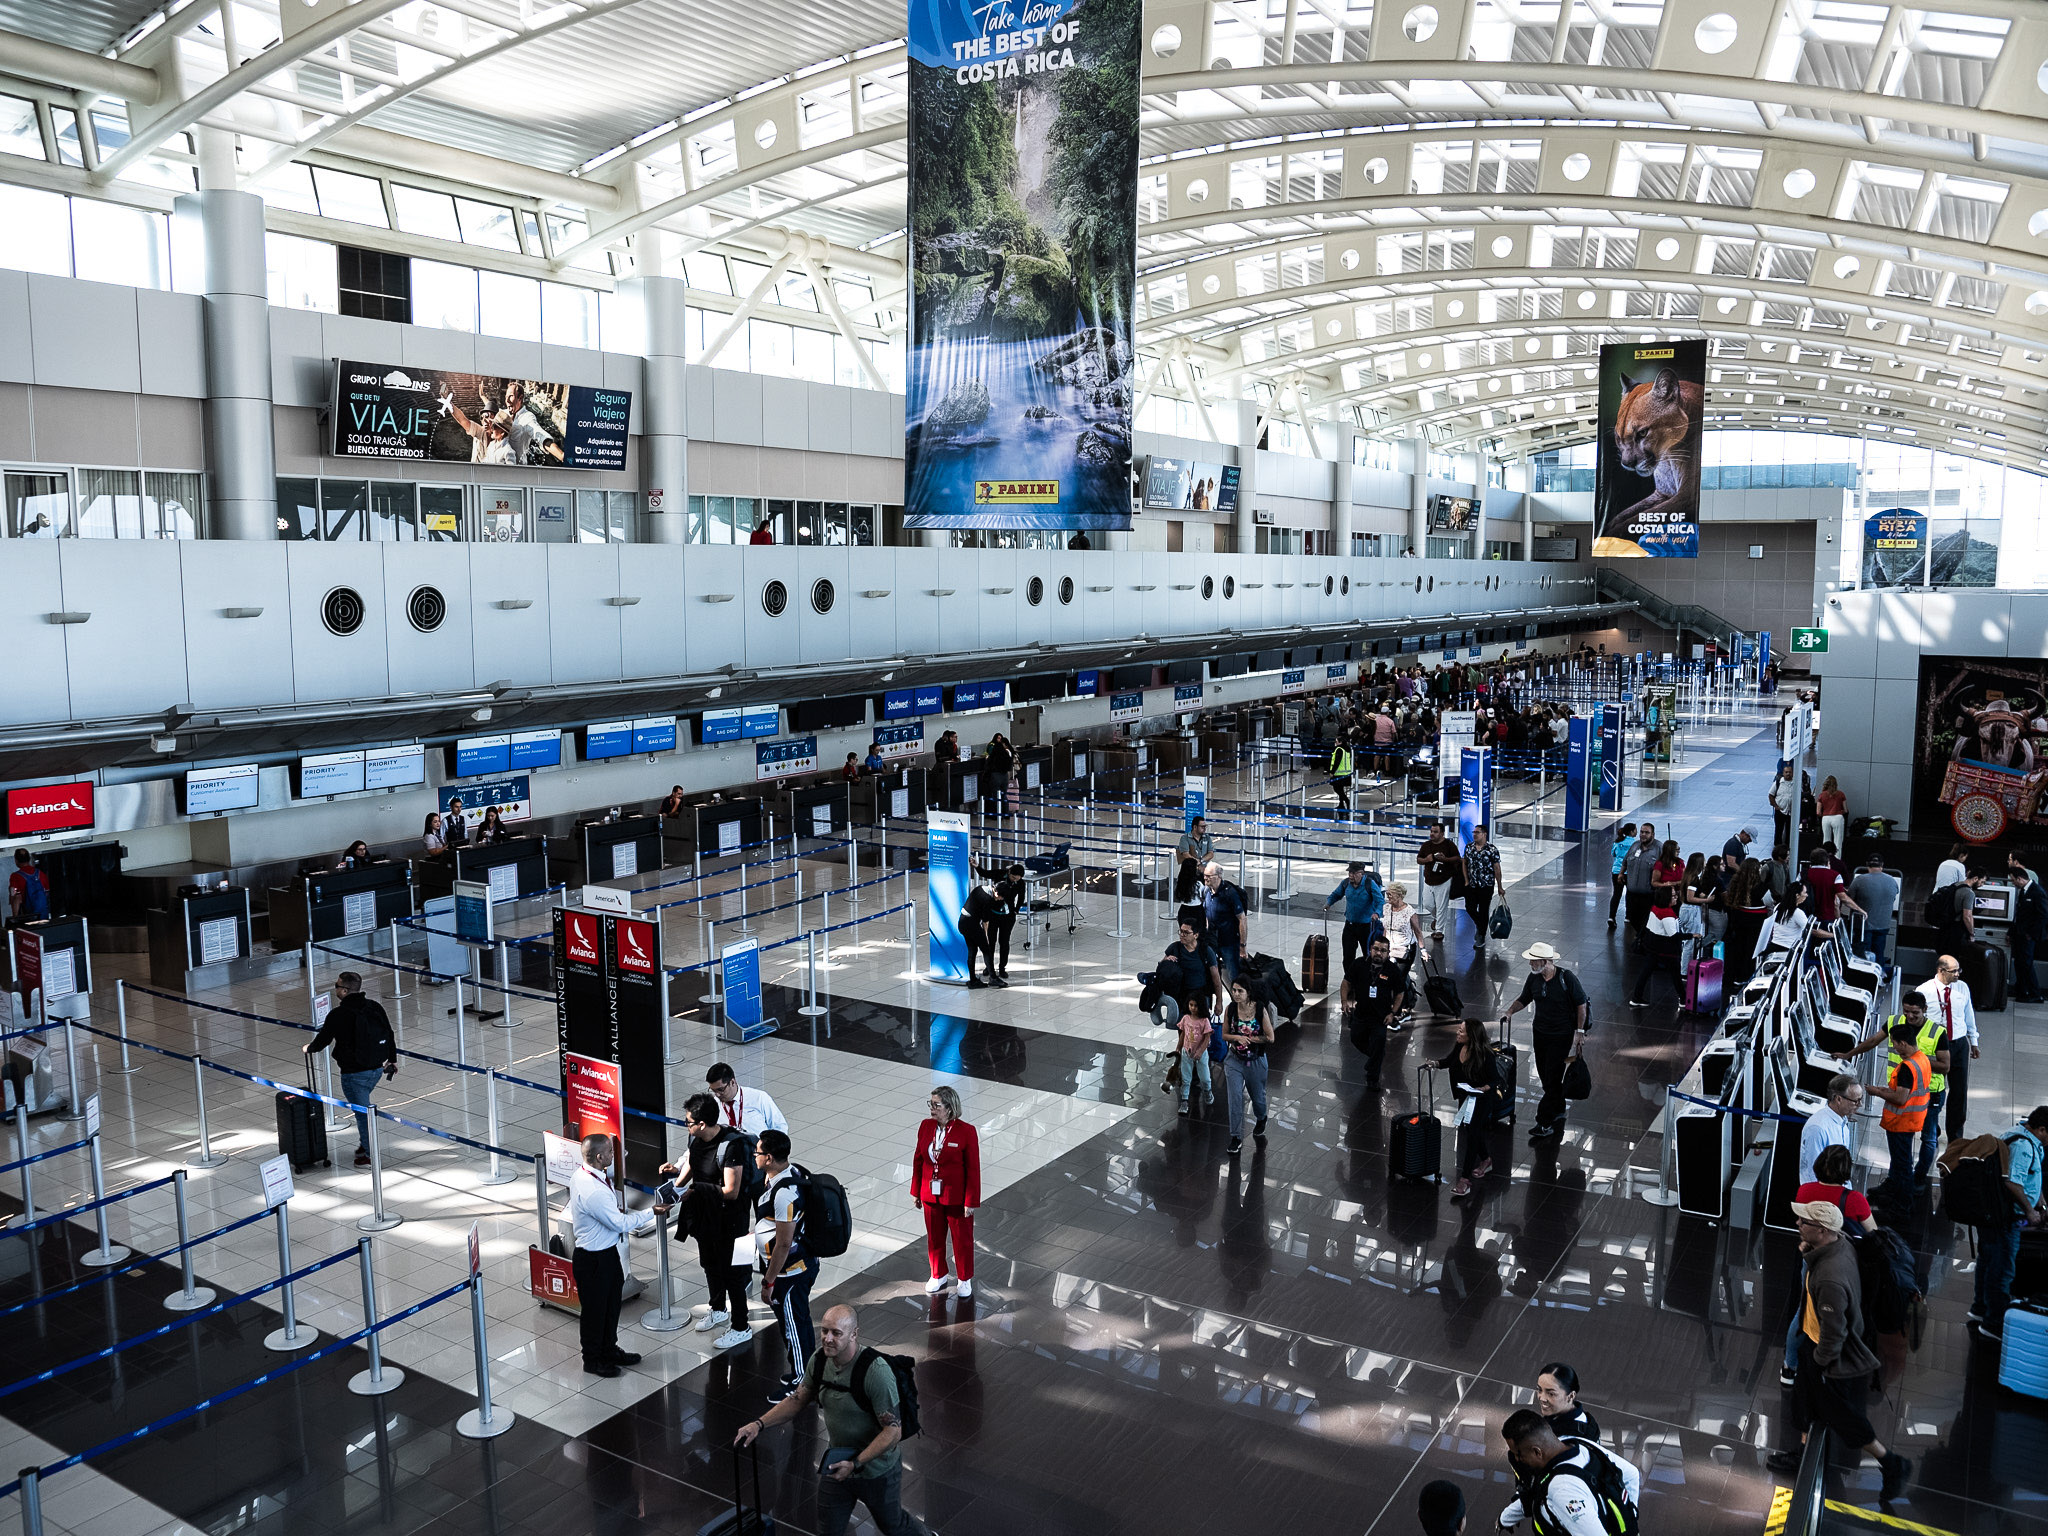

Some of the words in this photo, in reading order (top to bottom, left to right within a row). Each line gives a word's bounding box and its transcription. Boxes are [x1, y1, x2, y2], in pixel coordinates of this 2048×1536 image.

[972, 0, 1015, 38] Take
[1022, 0, 1062, 27] home
[952, 37, 991, 61] THE
[995, 27, 1047, 54] BEST
[1052, 20, 1080, 44] OF
[956, 57, 1020, 86] COSTA
[1025, 48, 1075, 74] RICA
[350, 374, 377, 385] GRUPO
[411, 381, 431, 390] INS
[595, 391, 627, 406] Seguro
[350, 402, 430, 436] VIAJE
[593, 406, 626, 421] Viajero
[578, 420, 592, 428] con
[592, 421, 625, 431] Asistencia
[348, 434, 371, 444] SOLO
[373, 435, 407, 446] TRAIGÁS
[347, 445, 379, 455] BUENOS
[380, 447, 424, 458] RECUERDOS
[998, 484, 1055, 495] PANINI
[1152, 478, 1176, 495] VIAJE
[496, 500, 509, 509] K-9
[538, 506, 565, 519] ACSI
[1638, 512, 1668, 523] BEST
[1669, 512, 1686, 523] OF
[1627, 523, 1665, 534] COSTA
[1666, 524, 1695, 534] RICA
[1879, 524, 1917, 532] RICA
[1603, 727, 1617, 735] Priority
[368, 760, 398, 768] PRIORITY
[304, 767, 336, 775] PRIORITY
[190, 781, 226, 790] PRIORITY
[1462, 778, 1471, 786] Bag
[1462, 784, 1474, 793] Drop
[15, 802, 69, 816] avianca
[932, 834, 948, 842] MAIN
[594, 894, 616, 903] American
[555, 926, 563, 966] GOLD
[569, 945, 597, 959] Avianca
[608, 935, 616, 975] GOLD
[623, 955, 651, 968] Avianca
[575, 963, 592, 971] CHECK-IN
[628, 972, 646, 980] CHECK-IN
[557, 971, 568, 1043] ALLIANCE
[608, 980, 619, 1049] ALLIANCE
[580, 1065, 608, 1082] Avianca
